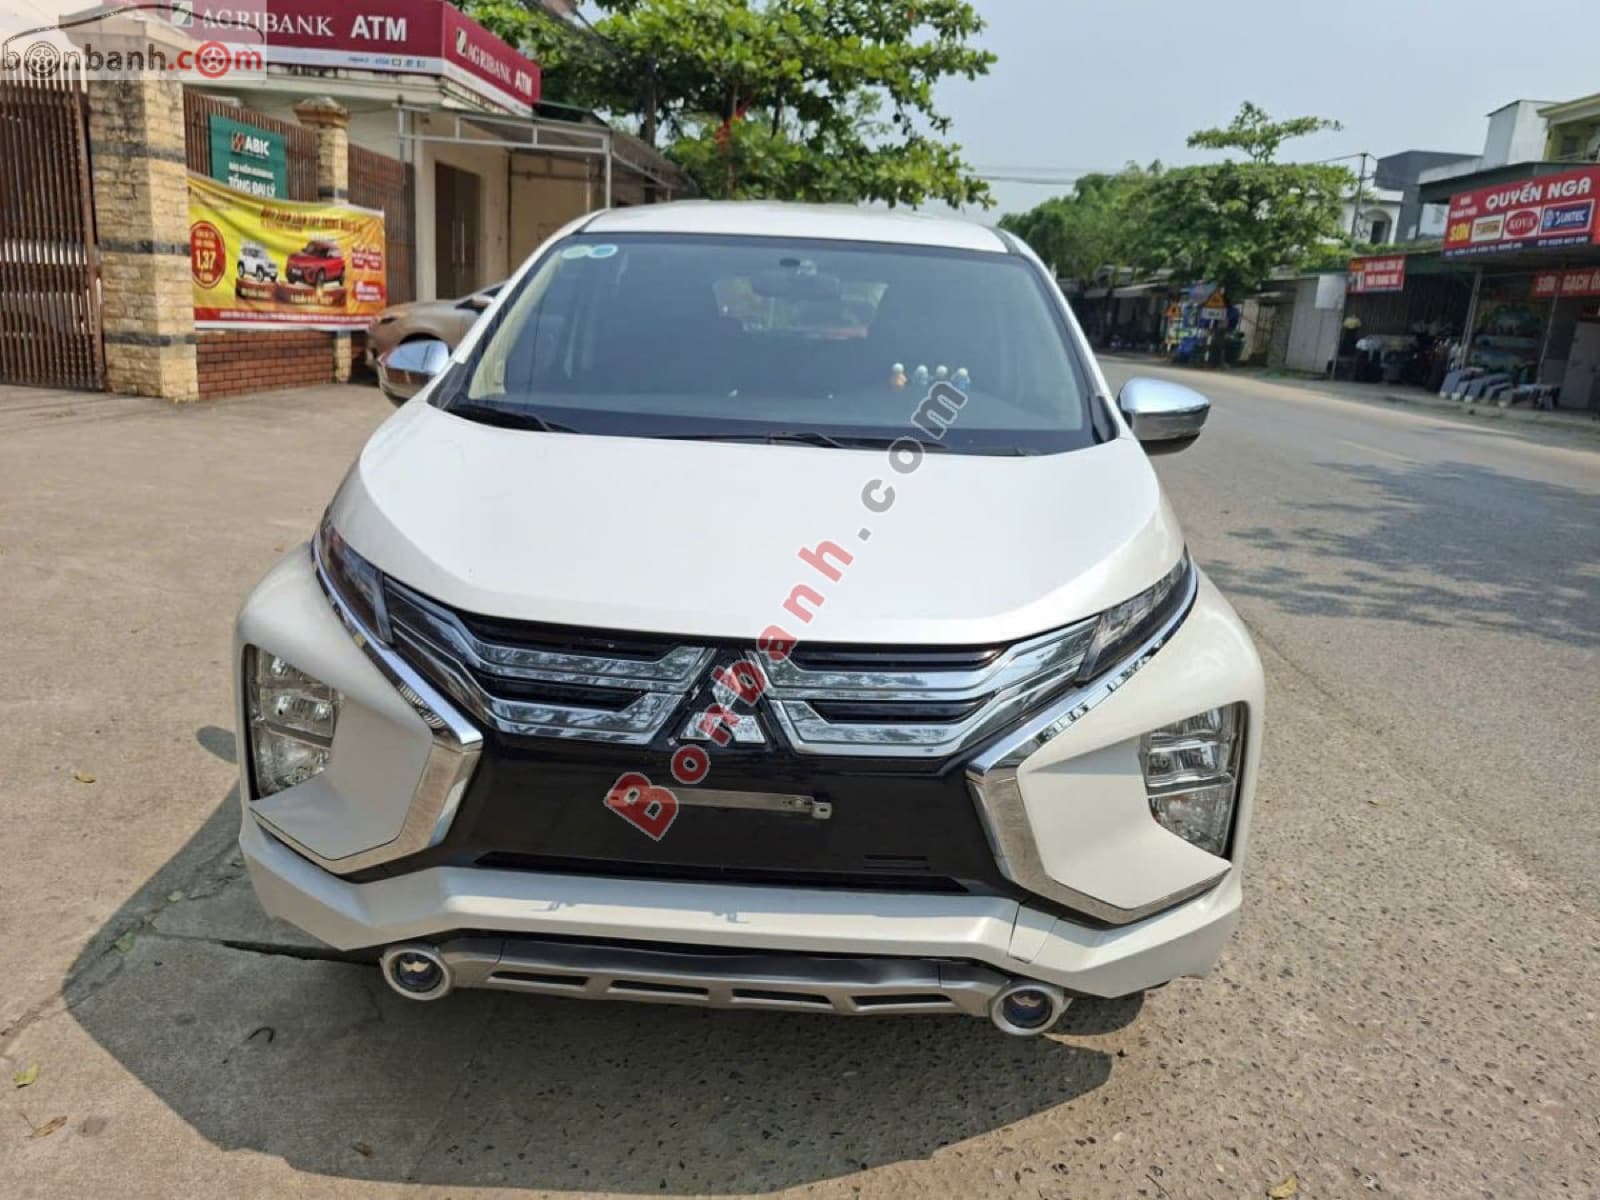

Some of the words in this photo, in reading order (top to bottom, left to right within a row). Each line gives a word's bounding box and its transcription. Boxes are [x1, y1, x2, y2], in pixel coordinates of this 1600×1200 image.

[201, 8, 334, 38] AGRIBANK
[350, 14, 408, 42] ATM
[467, 42, 512, 85] AGRIBANK
[514, 68, 533, 97] ATM
[1547, 176, 1592, 199] NGA
